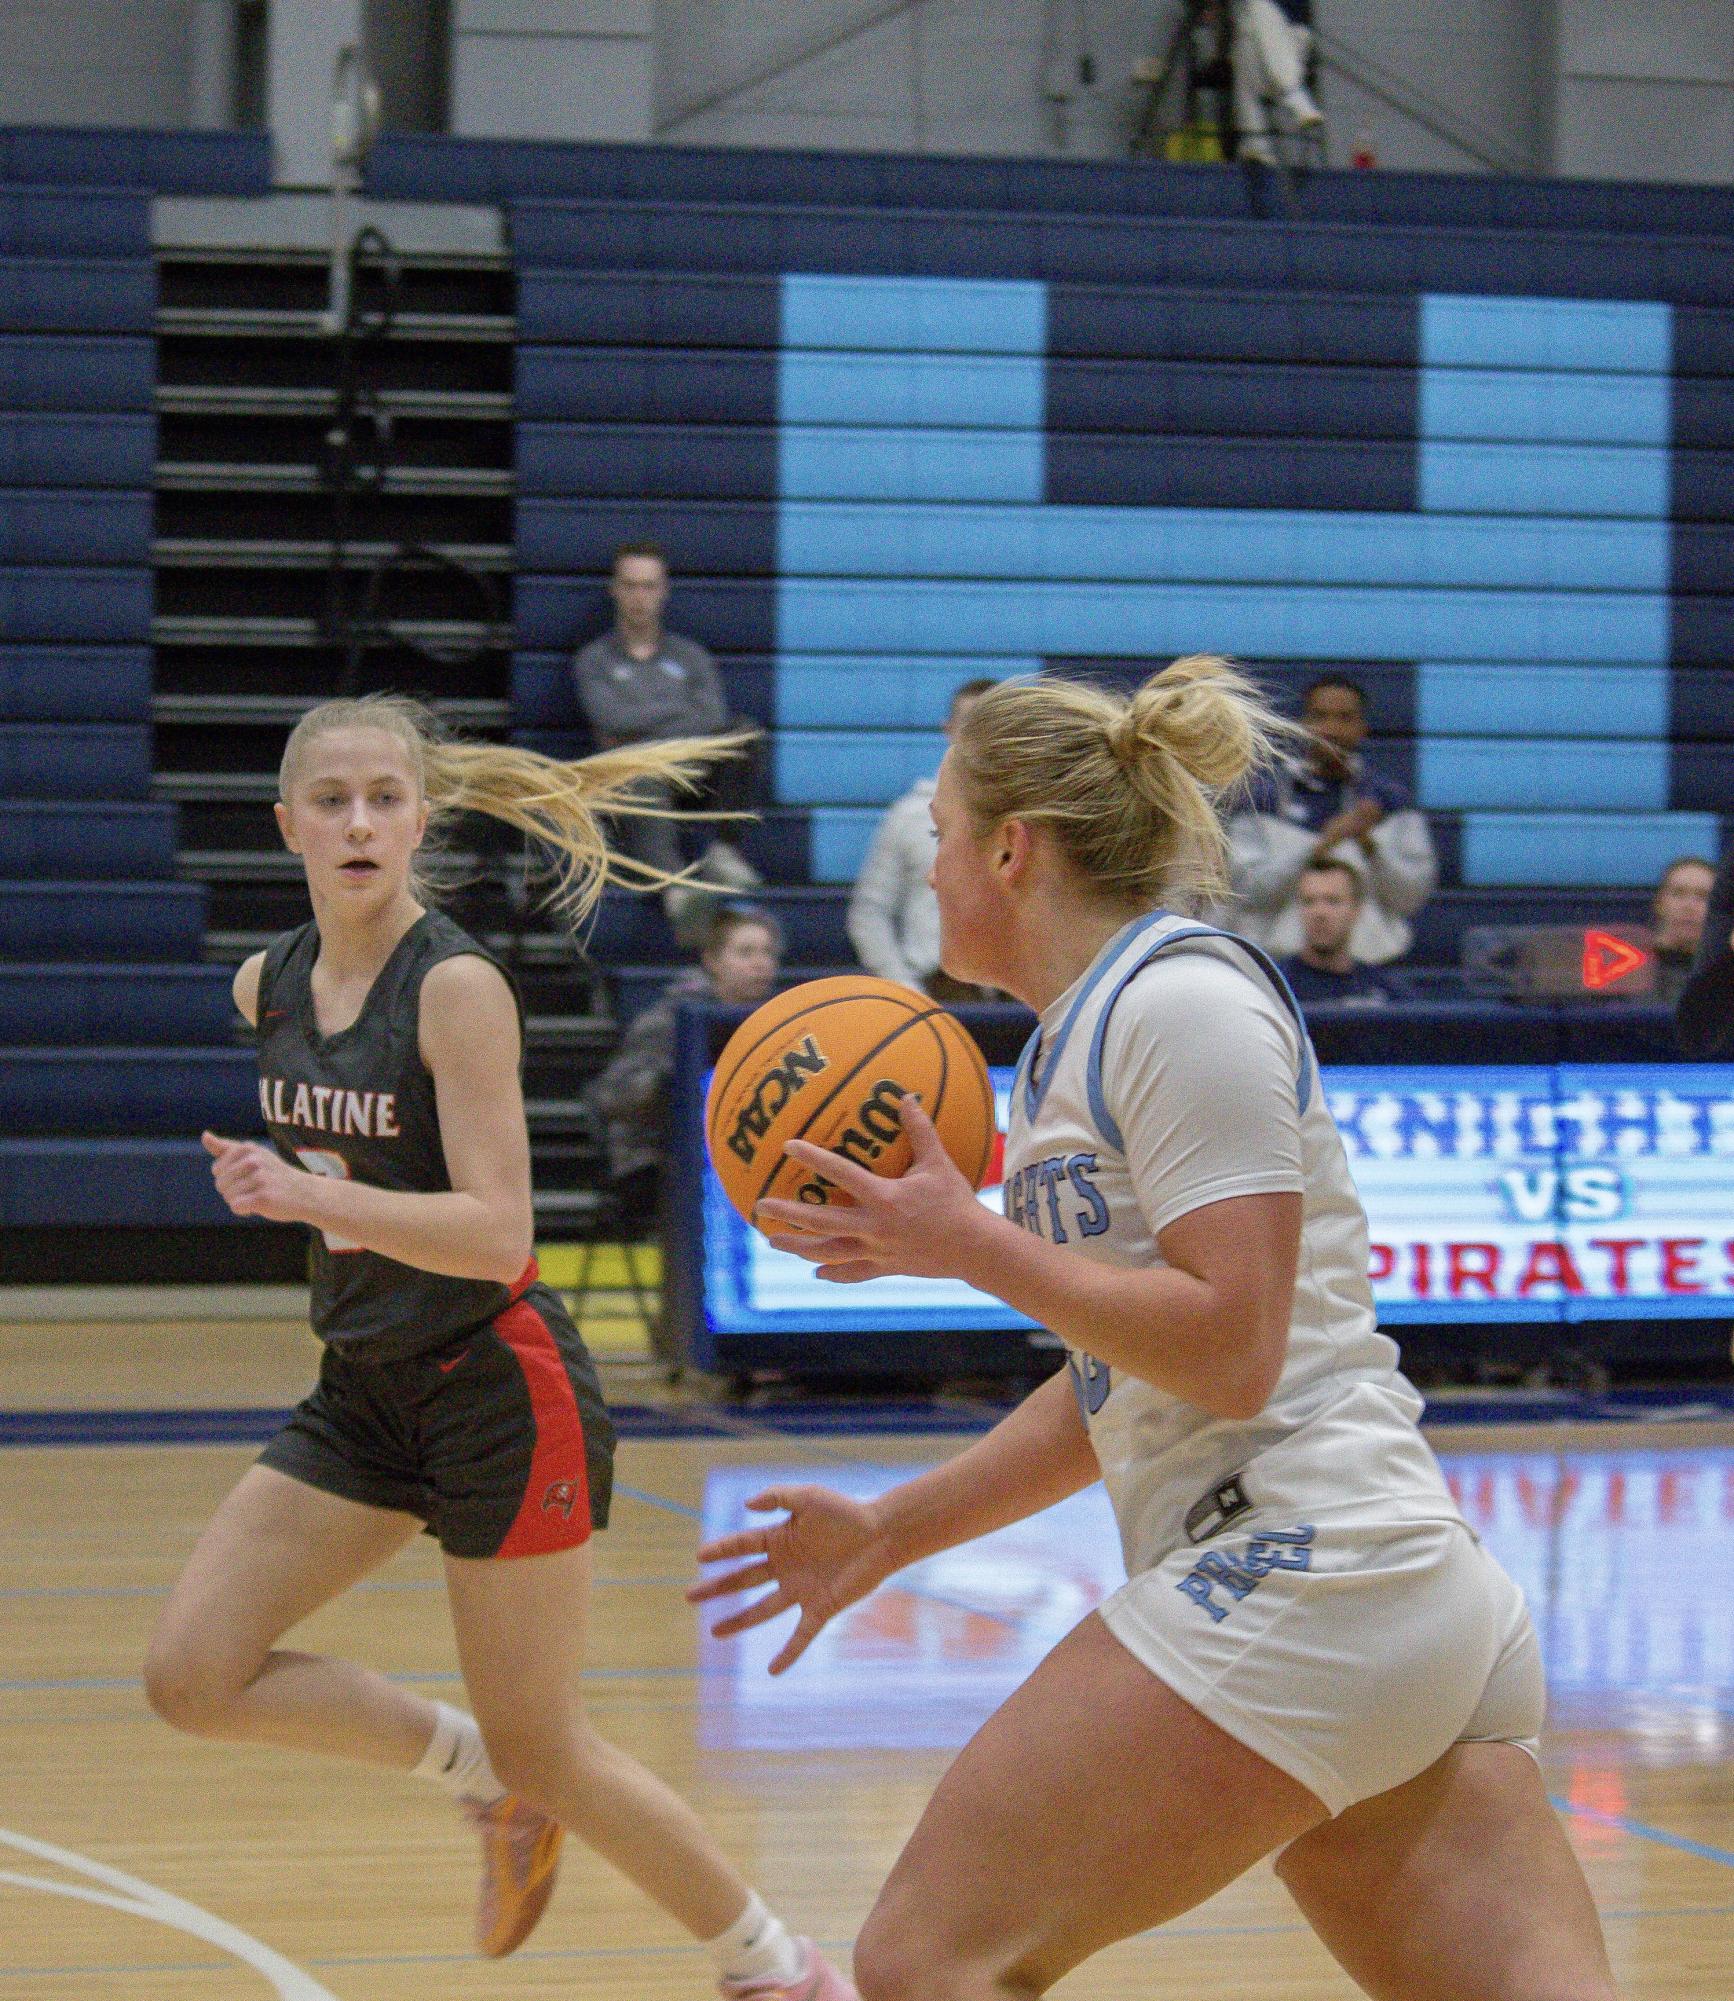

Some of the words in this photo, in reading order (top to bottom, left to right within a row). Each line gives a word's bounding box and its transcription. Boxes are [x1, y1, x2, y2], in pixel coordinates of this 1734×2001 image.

[727, 1033, 830, 1166] NCAA
[1502, 1164, 1626, 1222] VS
[1367, 1239, 1734, 1297] PIRATE
